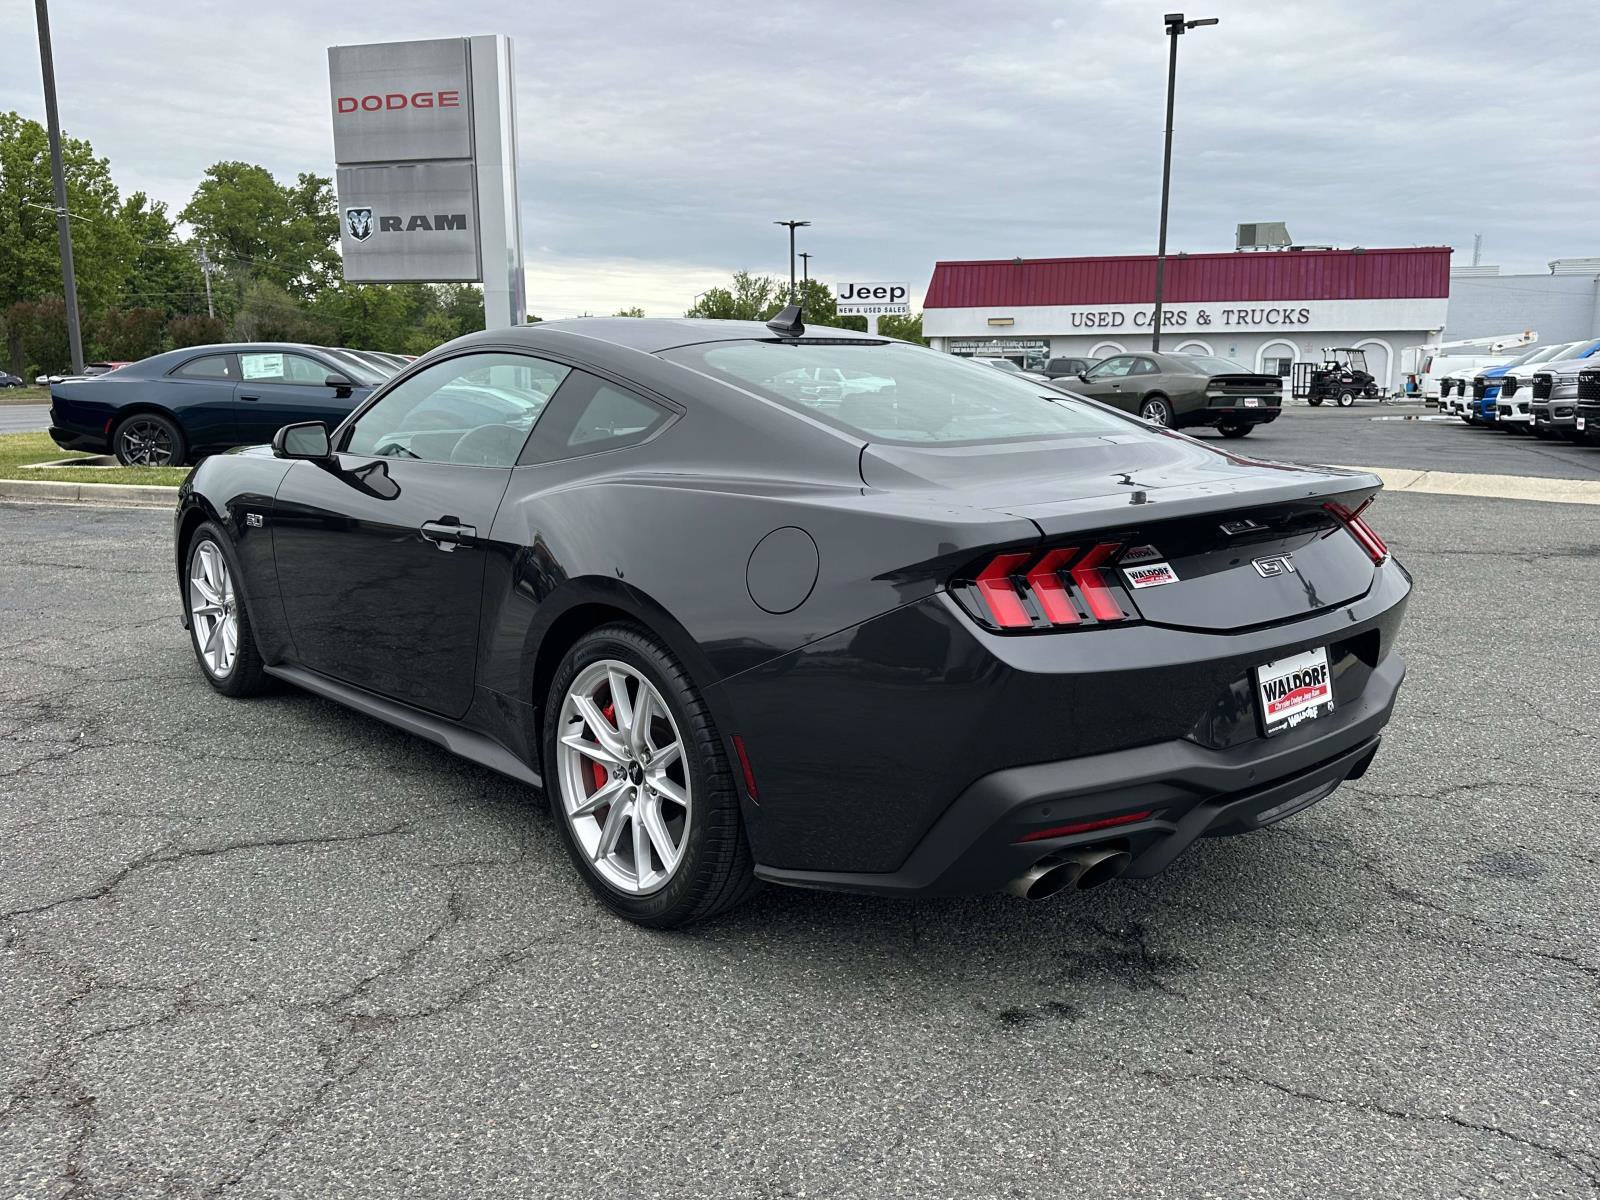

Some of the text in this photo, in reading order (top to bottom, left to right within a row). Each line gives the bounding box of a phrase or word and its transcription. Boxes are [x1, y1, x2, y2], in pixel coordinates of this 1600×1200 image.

[337, 91, 460, 113] DODGE
[379, 214, 467, 232] RAM
[840, 283, 905, 302] Jeep
[1071, 312, 1125, 328] USED
[1196, 309, 1212, 325] &
[1222, 308, 1310, 325] TRUCKS
[1128, 567, 1170, 580] WALDORF
[1251, 552, 1293, 578] GT
[1263, 665, 1326, 702] WALDORF
